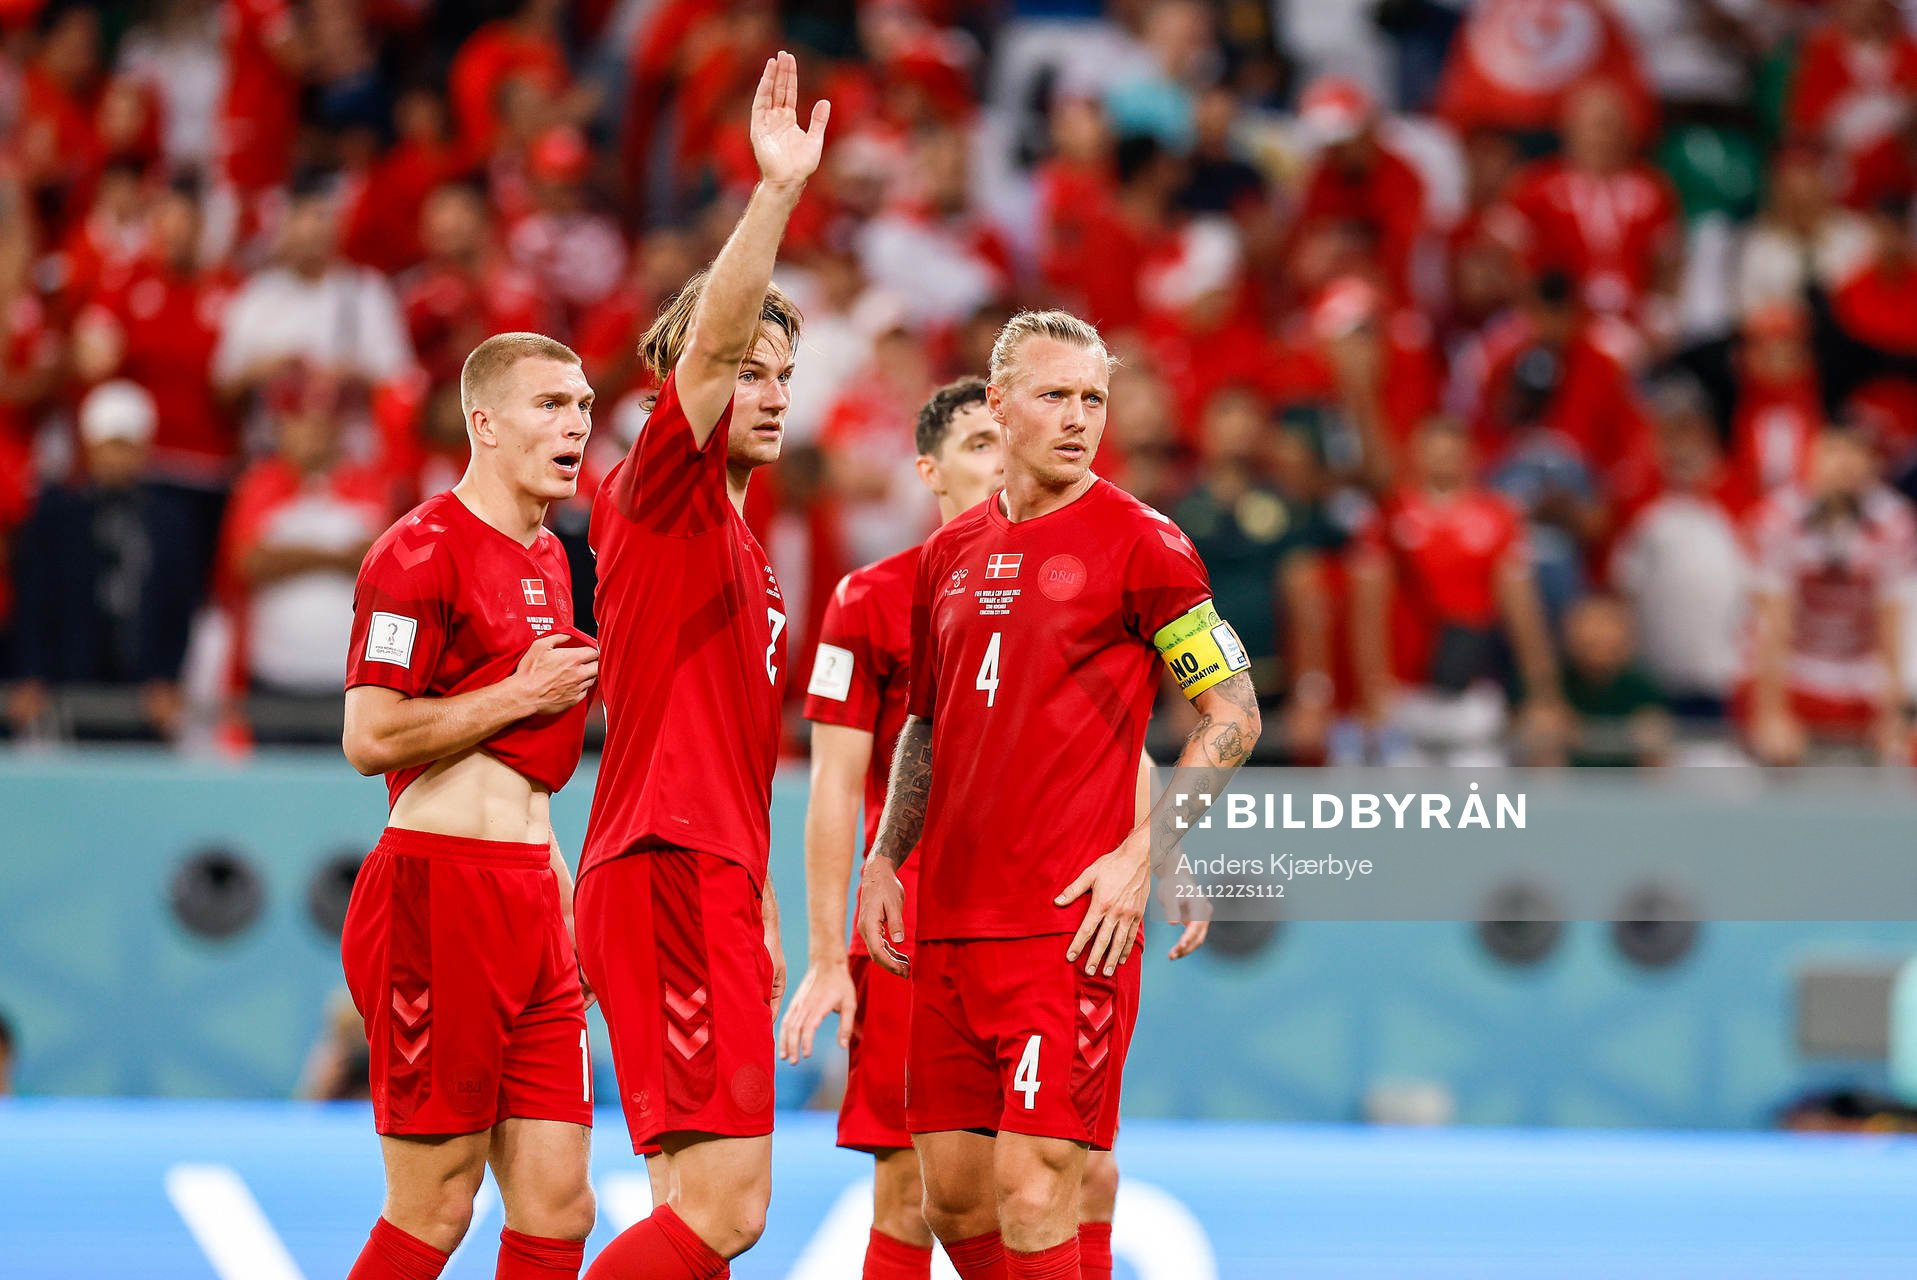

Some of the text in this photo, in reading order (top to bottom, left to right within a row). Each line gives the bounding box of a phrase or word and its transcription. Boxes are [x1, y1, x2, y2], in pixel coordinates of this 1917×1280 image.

[766, 607, 786, 686] 2
[976, 632, 1001, 707] 4
[1169, 652, 1199, 681] NO
[1013, 1035, 1042, 1109] 4
